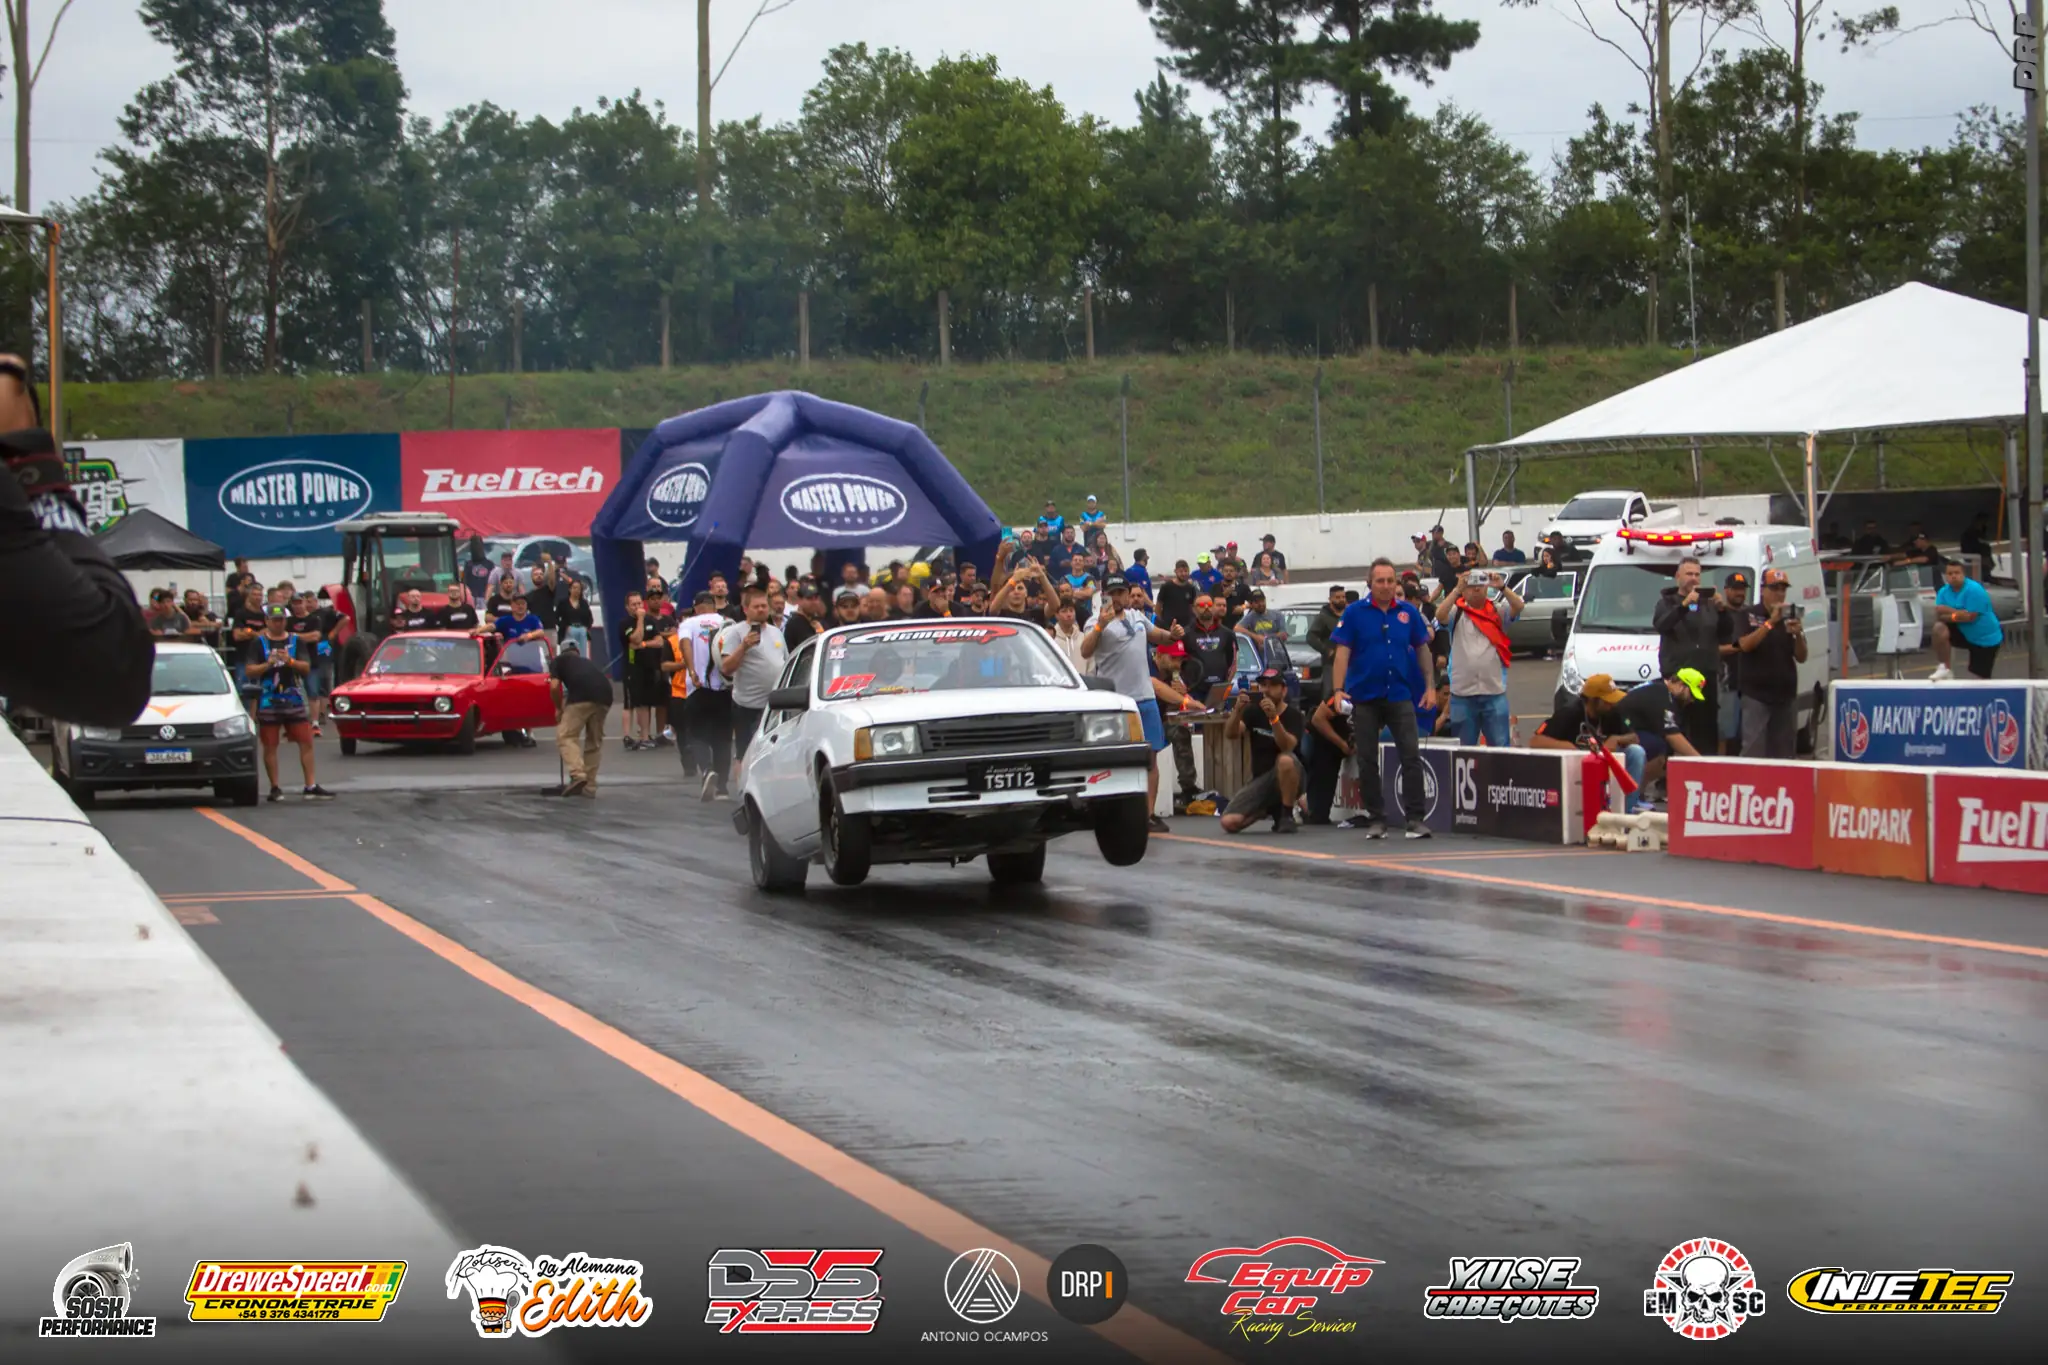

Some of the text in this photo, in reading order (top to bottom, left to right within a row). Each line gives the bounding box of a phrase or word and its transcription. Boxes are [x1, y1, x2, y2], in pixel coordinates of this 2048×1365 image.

[231, 472, 360, 505] MASTER POWER
[422, 466, 604, 494] FuelTech
[790, 483, 896, 513] MASTER POWER
[1871, 705, 1983, 736] MAKIN' POWER!
[1455, 757, 1477, 810] RS
[1684, 781, 1794, 834] FuelTech
[1828, 802, 1913, 846] VELOPARK
